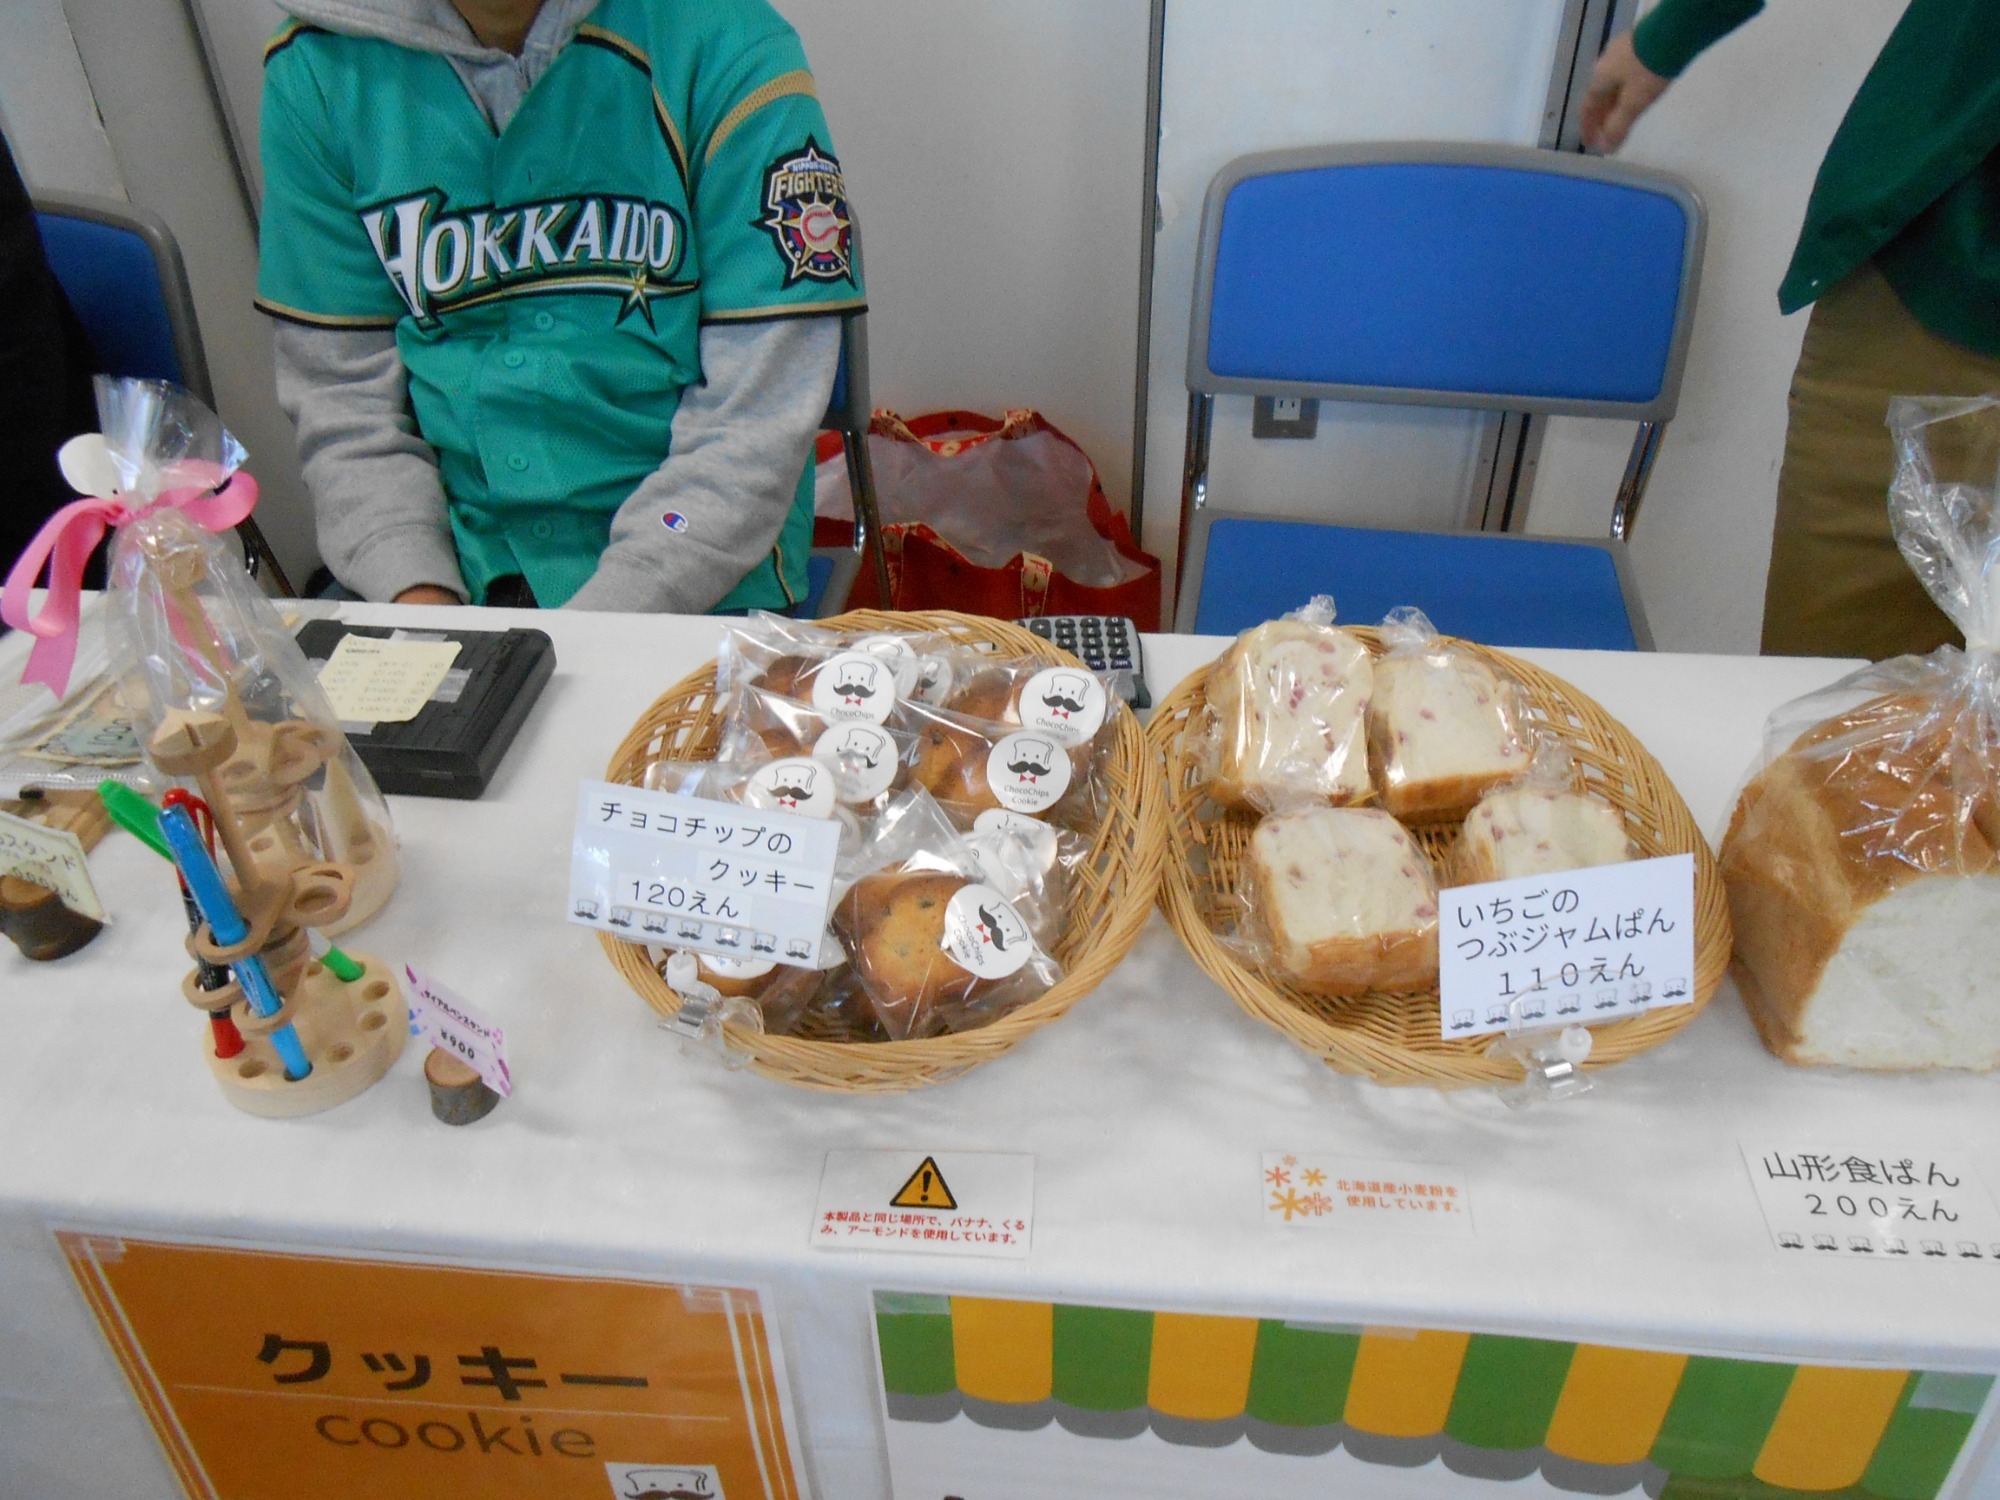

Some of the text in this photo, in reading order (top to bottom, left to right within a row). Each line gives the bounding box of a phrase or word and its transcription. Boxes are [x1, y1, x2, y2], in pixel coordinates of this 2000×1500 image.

[773, 171, 847, 203] FIGHTERS
[360, 197, 676, 319] HOKKAIDO
[830, 707, 875, 720] ChocoChips
[1004, 784, 1050, 798] ChocoChips
[1011, 797, 1039, 806] Cookie
[601, 802, 792, 854] チョコチップの
[709, 859, 815, 893] クッキー
[632, 880, 739, 919] 120えん
[1457, 888, 1579, 929] いちごの
[1457, 907, 1675, 961] つぶジャムぱん
[1498, 953, 1645, 997] 110えん
[1763, 1152, 1959, 1187] 山形食ぱん
[1336, 1179, 1458, 1198] 北海道産小麦粉を
[1346, 1195, 1462, 1214] 使用しています。
[823, 1211, 1026, 1231] 本製品と同じ場所で、バナナ、くる
[1804, 1193, 1959, 1222] 200えん
[820, 1225, 1017, 1246] み、アーモンドを使用しています。
[256, 1333, 649, 1401] クッキー
[314, 1411, 596, 1459] cookie
